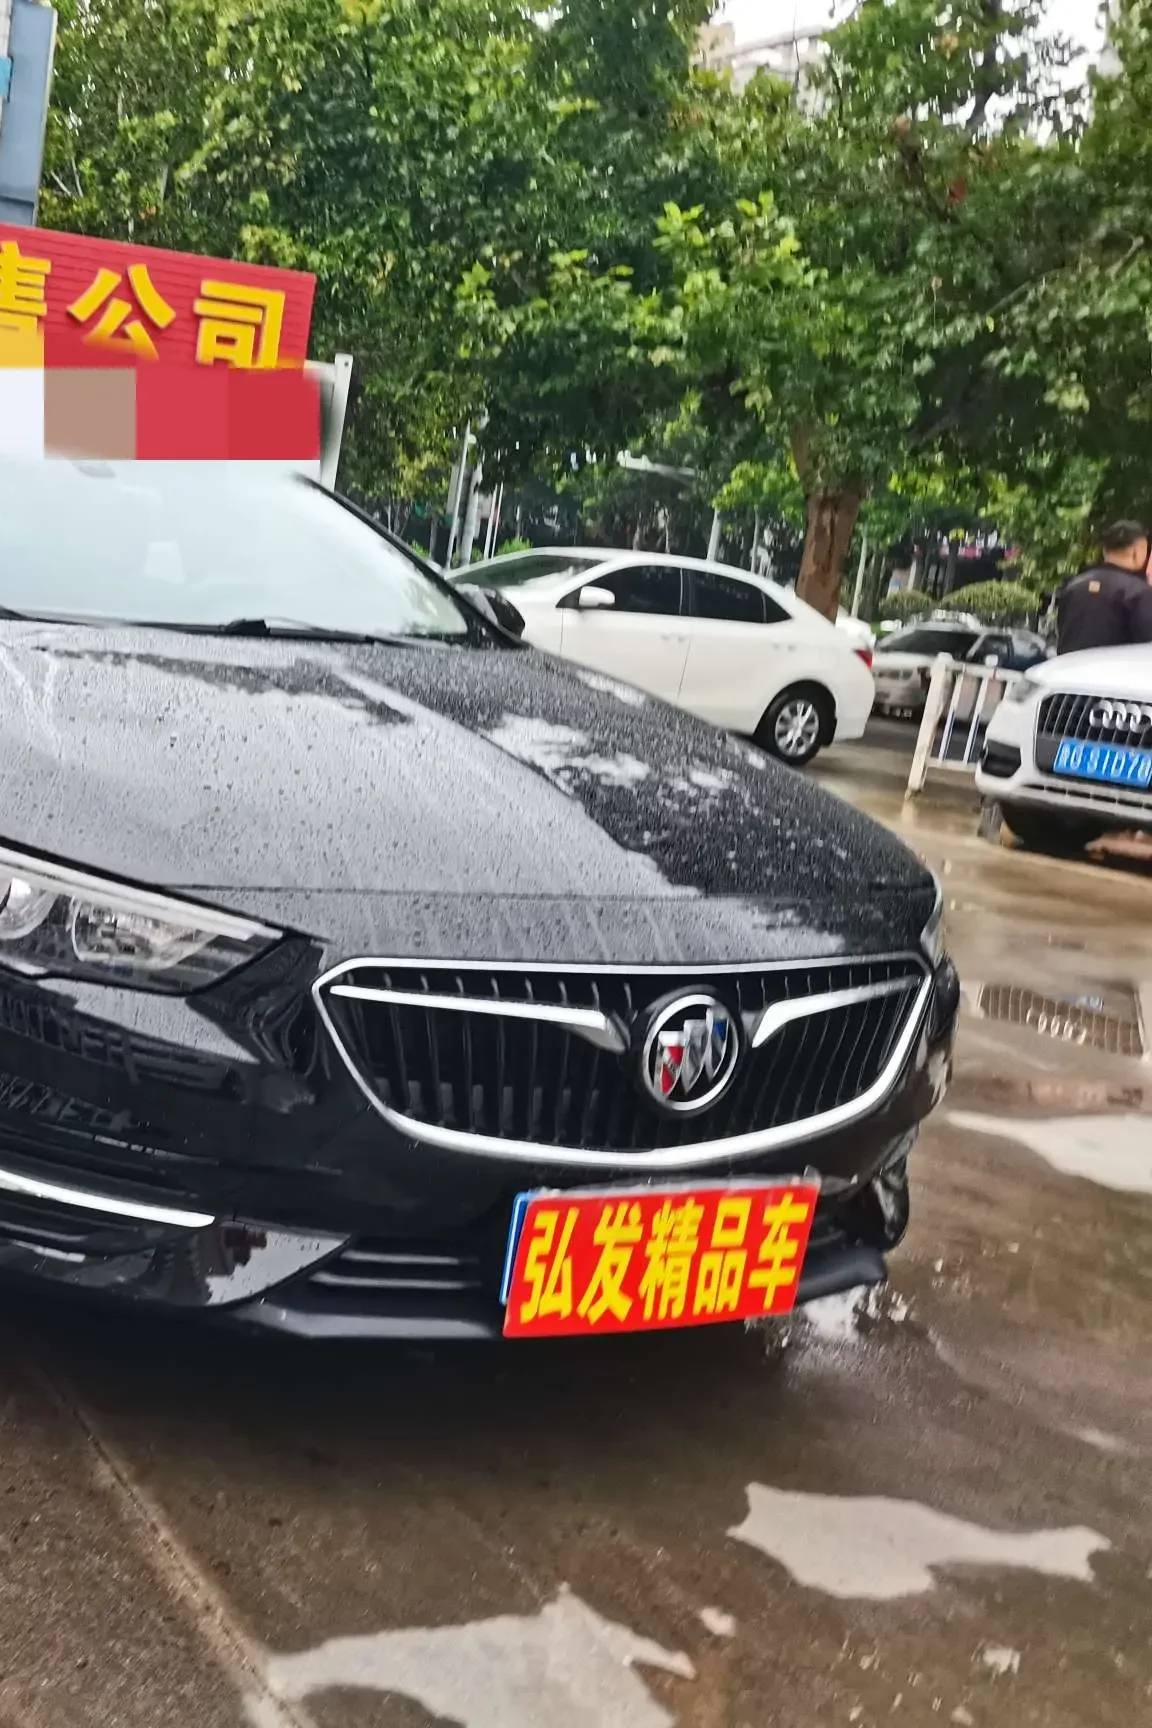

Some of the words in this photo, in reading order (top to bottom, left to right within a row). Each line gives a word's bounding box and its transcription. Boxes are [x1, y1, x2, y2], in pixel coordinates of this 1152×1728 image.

[519, 1191, 809, 1326] 弘发精品车
